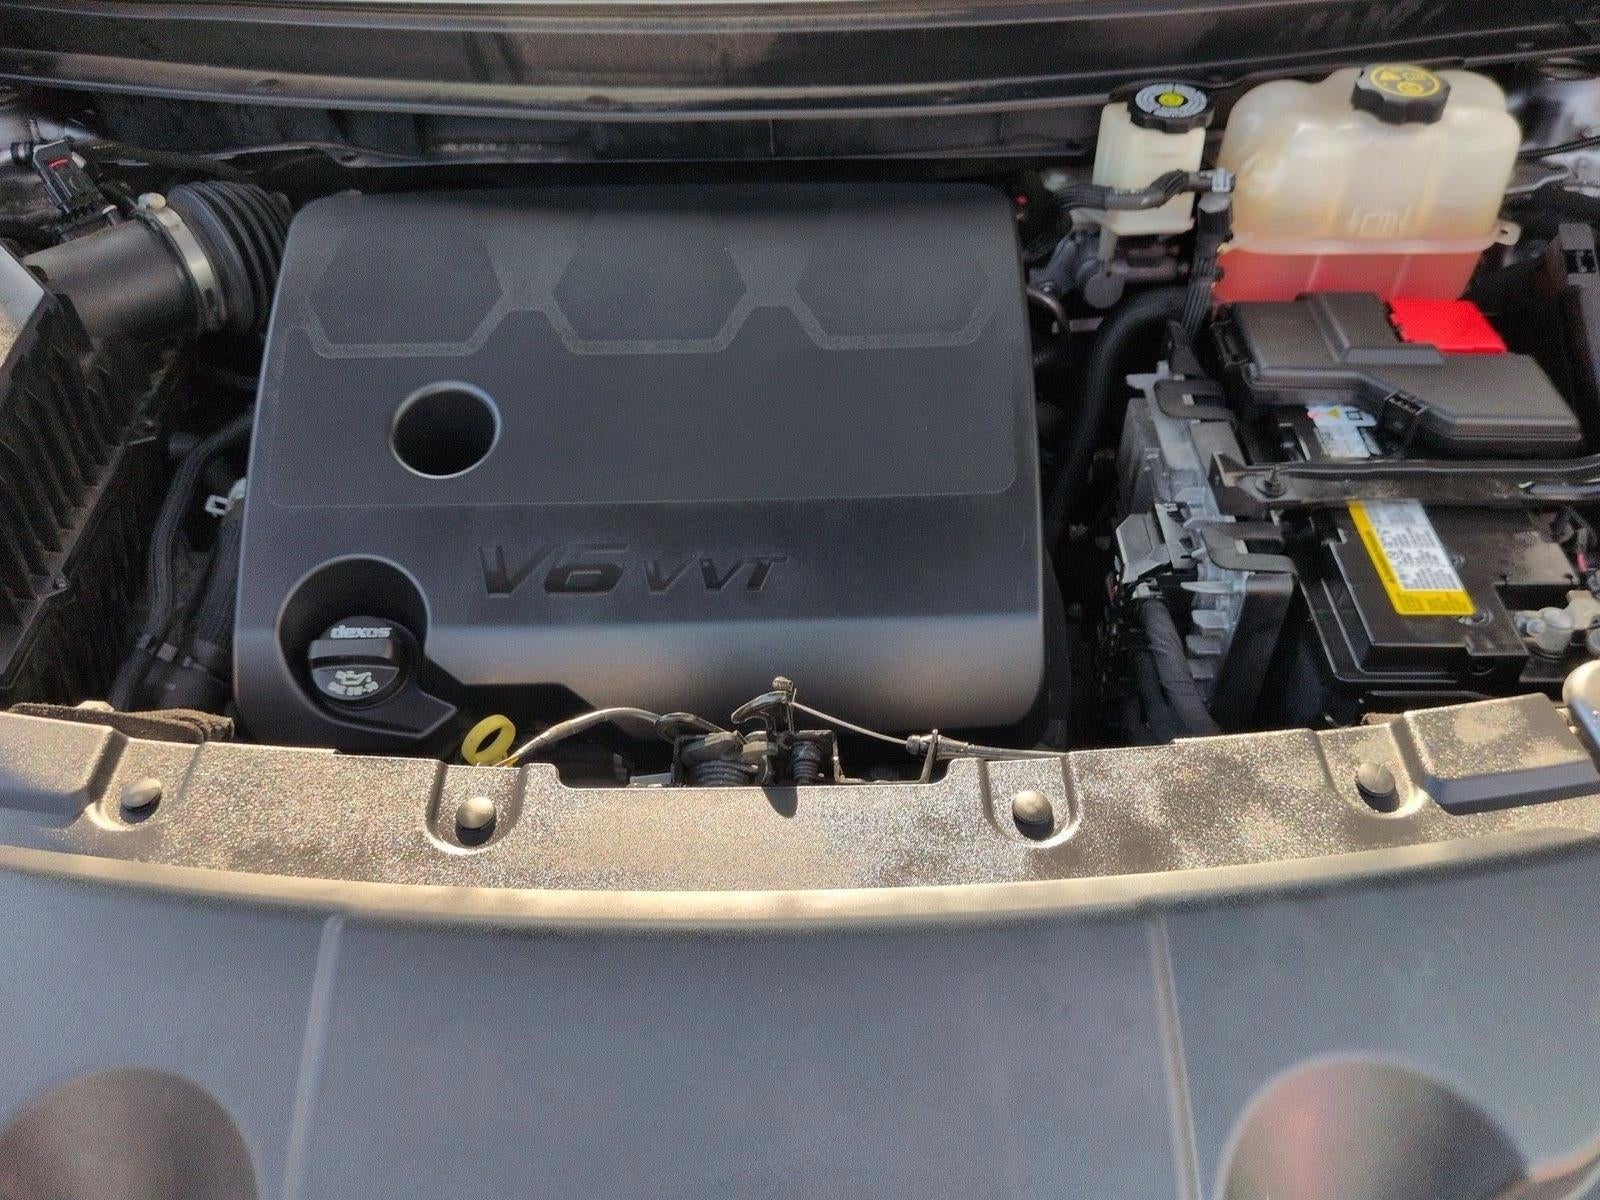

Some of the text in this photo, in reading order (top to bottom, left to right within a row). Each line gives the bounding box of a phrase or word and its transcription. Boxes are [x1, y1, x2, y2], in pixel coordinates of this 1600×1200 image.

[478, 543, 789, 597] V6 VVT
[330, 624, 392, 639] dexos
